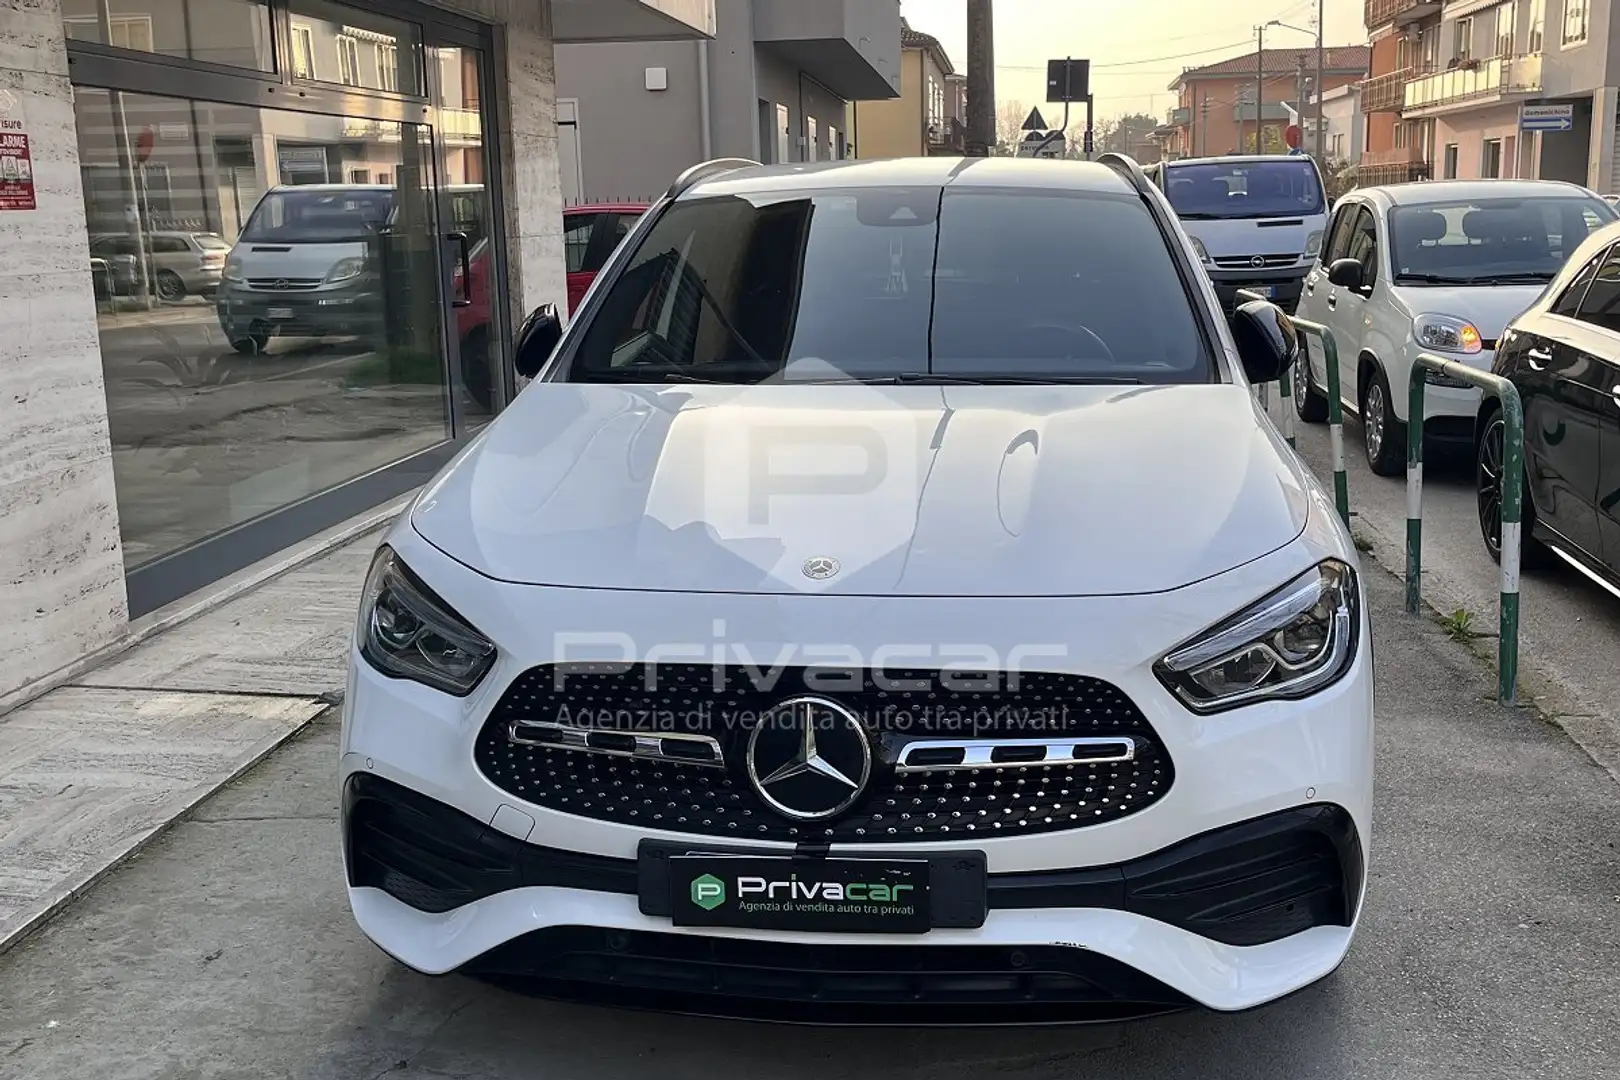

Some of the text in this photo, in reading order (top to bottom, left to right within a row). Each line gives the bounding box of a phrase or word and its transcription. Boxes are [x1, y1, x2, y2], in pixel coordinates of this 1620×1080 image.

[697, 883, 721, 901] P
[737, 873, 914, 902] Privacar
[738, 900, 914, 917] Agenzia di vendita auto tra privati
